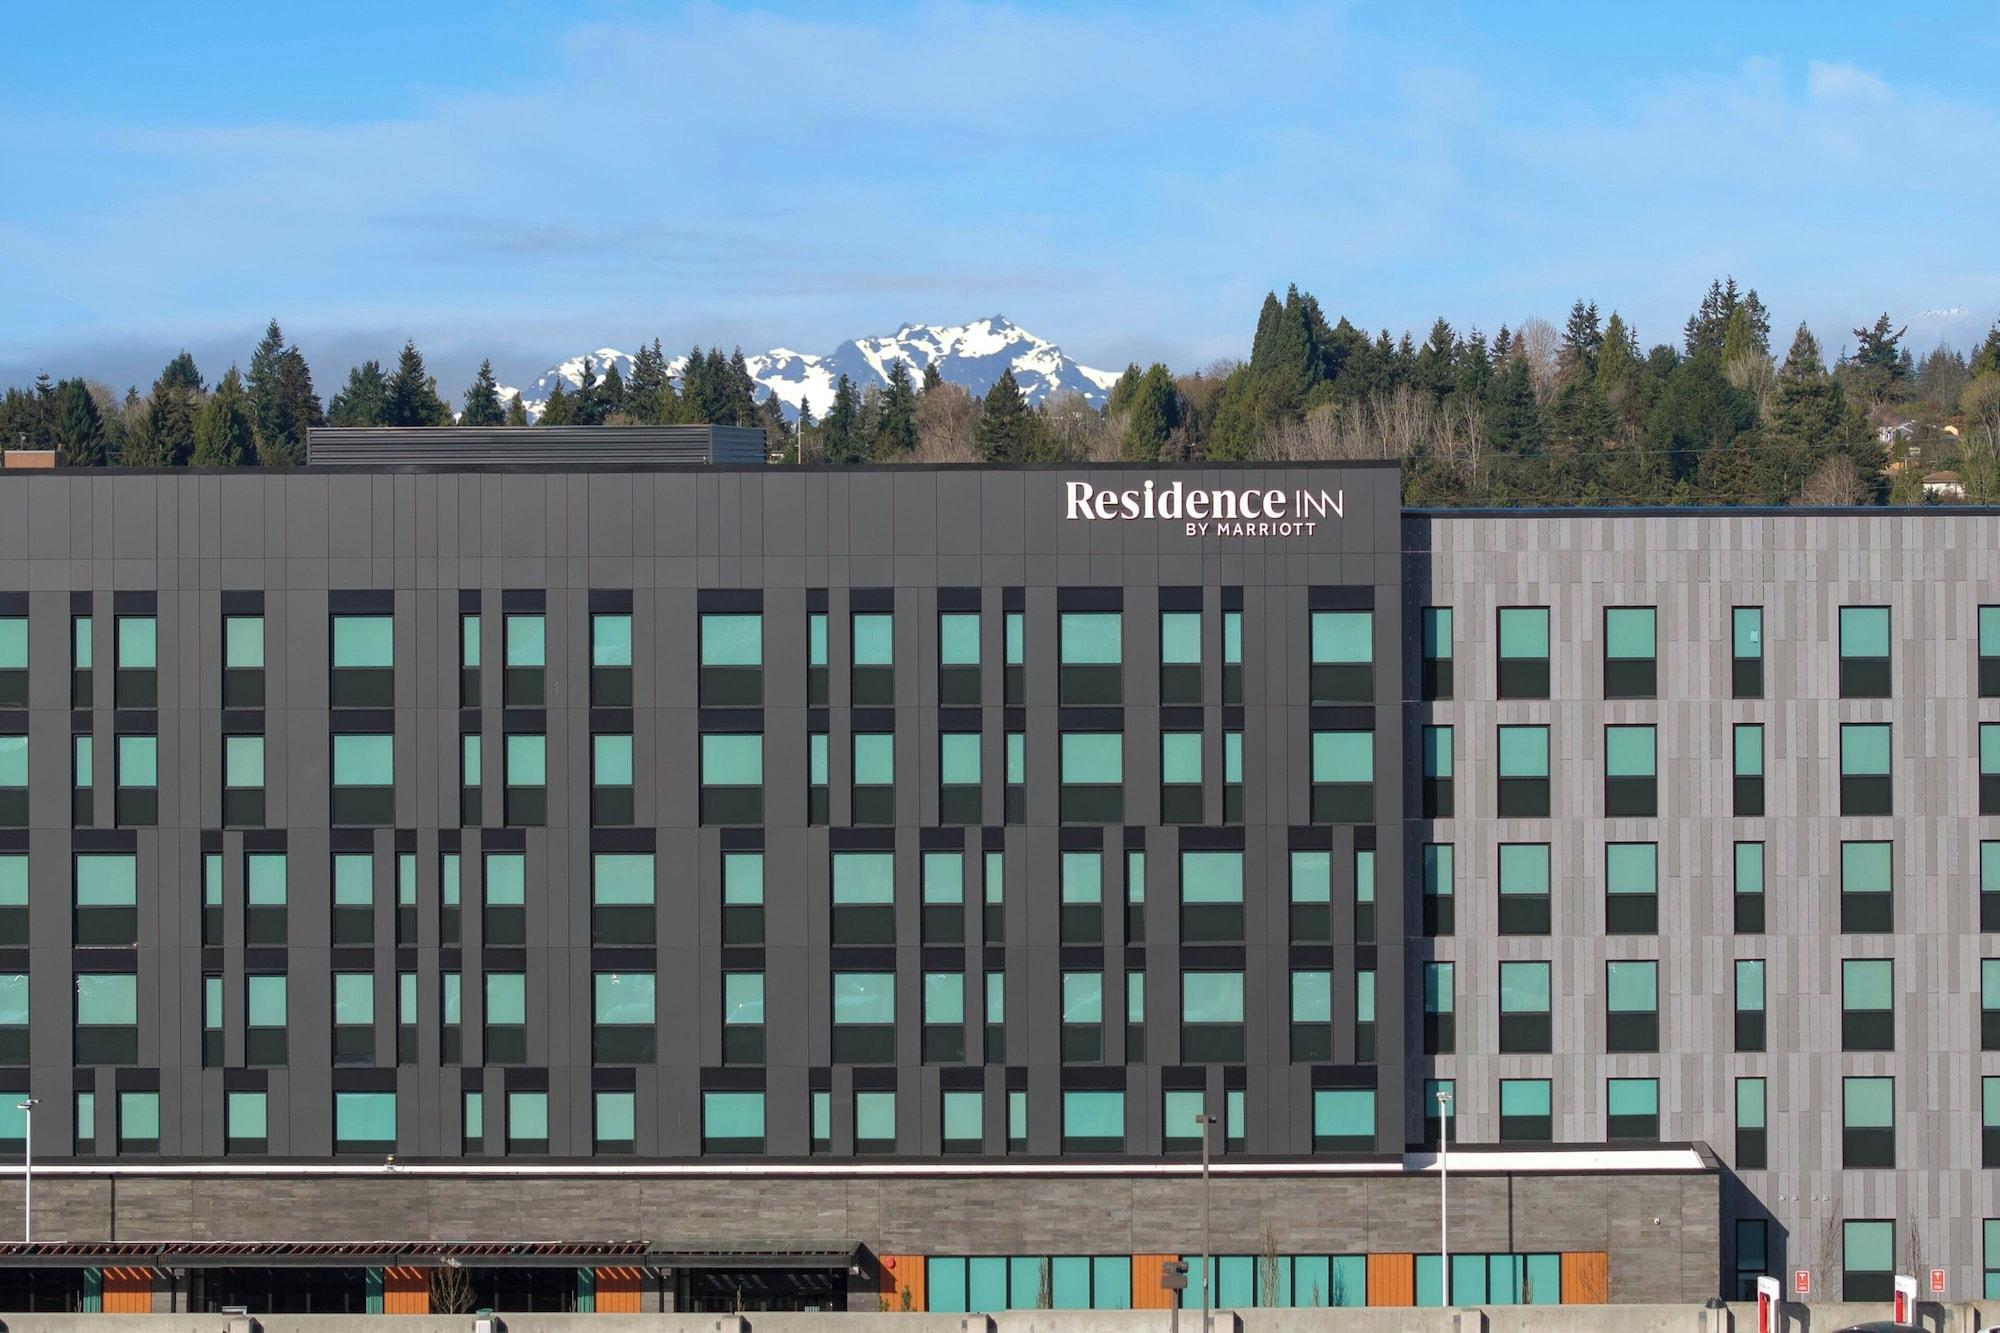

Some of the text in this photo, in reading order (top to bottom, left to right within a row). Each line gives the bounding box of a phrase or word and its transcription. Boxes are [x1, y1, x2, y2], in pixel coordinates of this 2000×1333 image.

[1066, 480, 1343, 520] Residence INN
[1186, 522, 1316, 536] BY MARRIOTT
